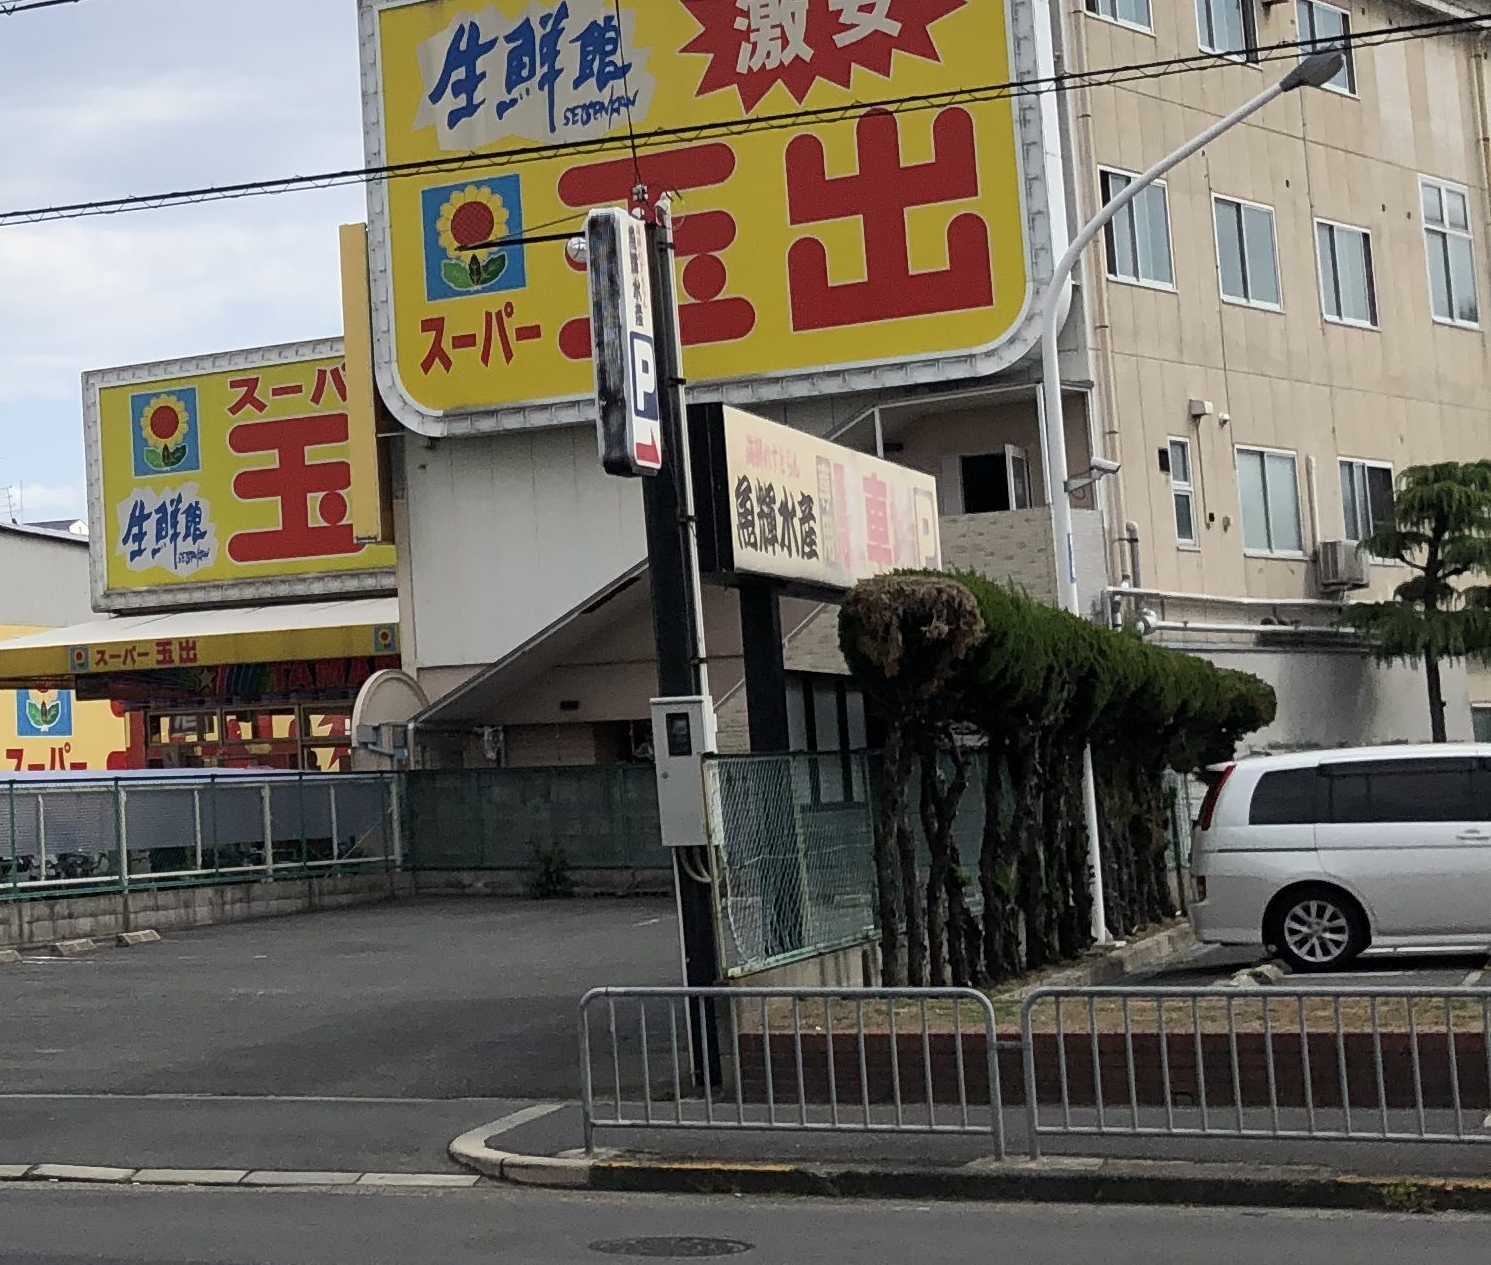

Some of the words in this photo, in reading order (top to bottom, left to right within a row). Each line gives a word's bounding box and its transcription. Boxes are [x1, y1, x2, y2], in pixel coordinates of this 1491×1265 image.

[428, 0, 633, 134] 生鮮館
[557, 107, 996, 361] 玉出
[419, 301, 542, 377] スーパー
[633, 339, 655, 412] P
[121, 492, 208, 569] 生鮮館
[95, 646, 150, 666] スーパー
[155, 639, 198, 665] 玉出
